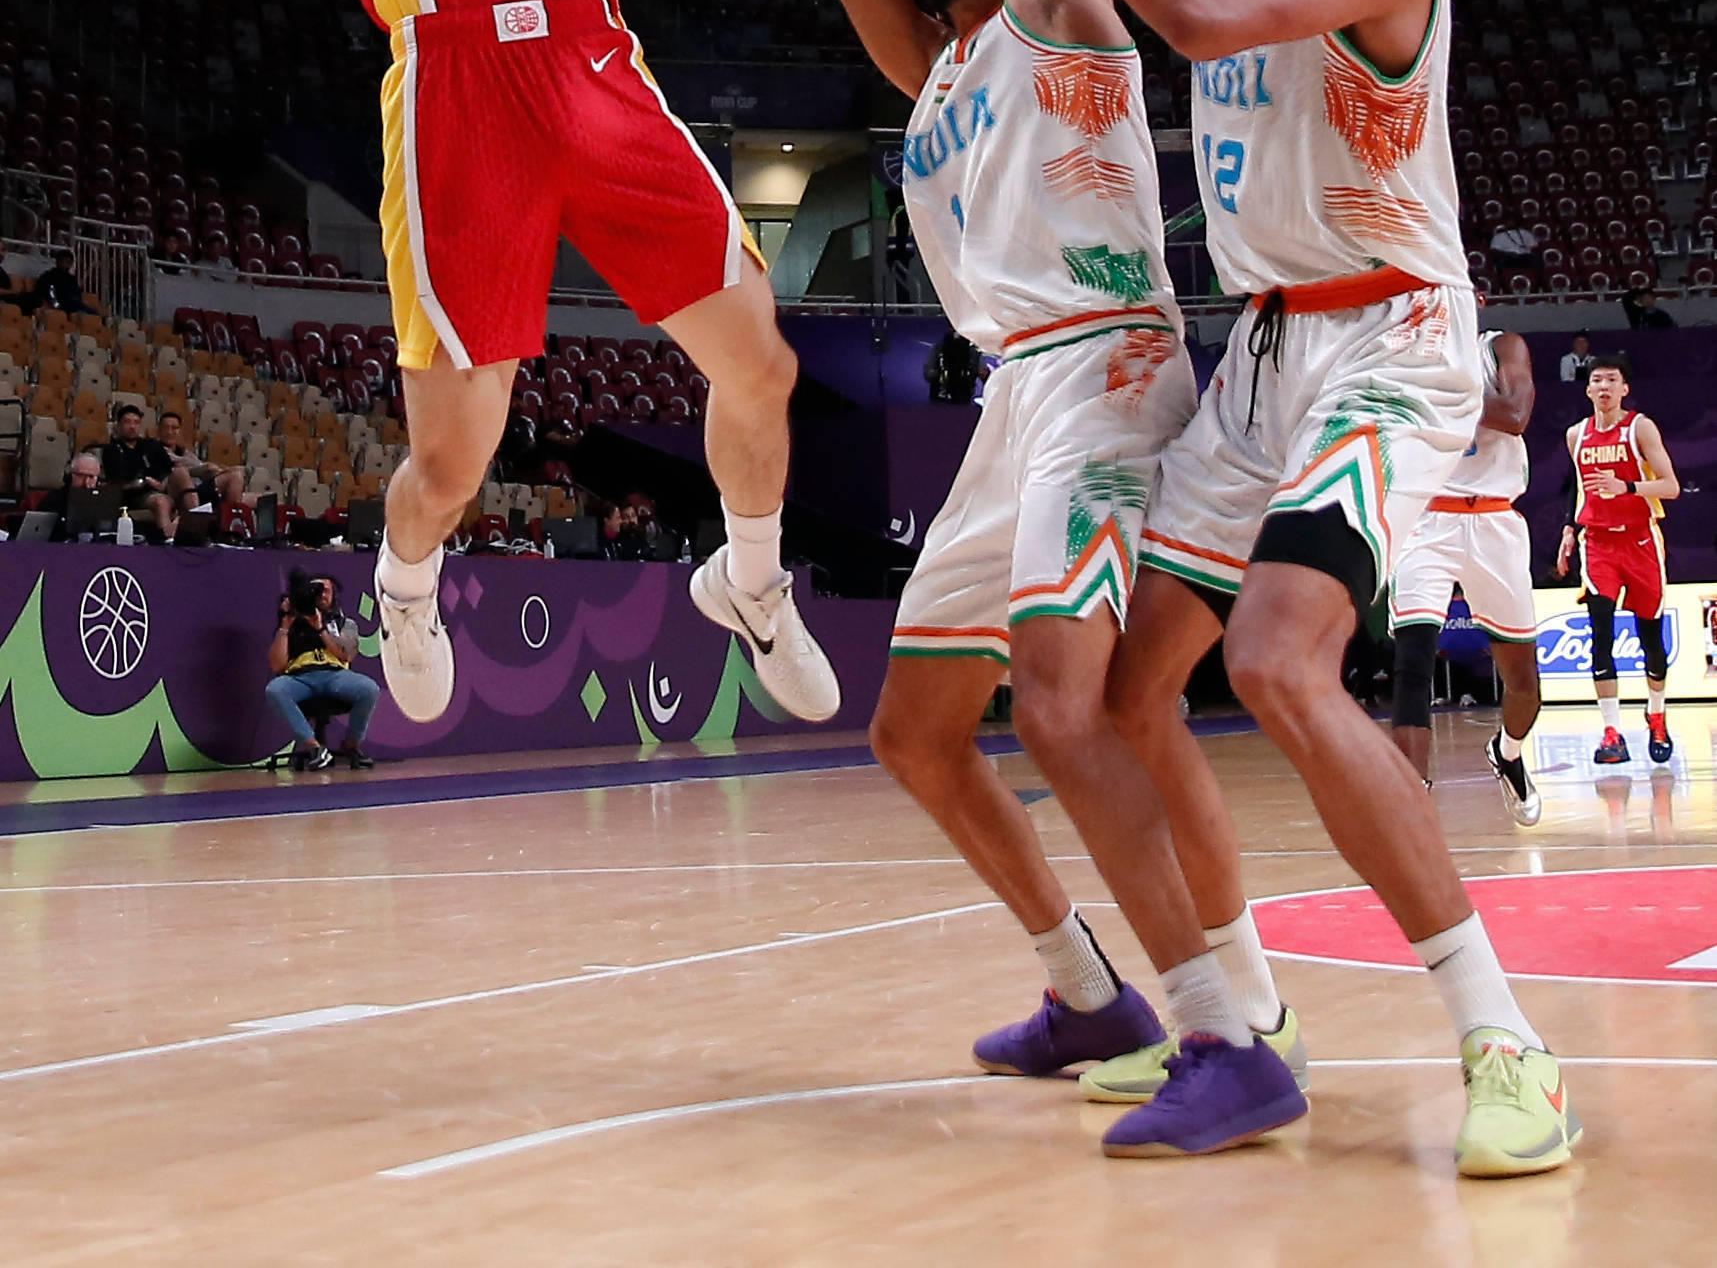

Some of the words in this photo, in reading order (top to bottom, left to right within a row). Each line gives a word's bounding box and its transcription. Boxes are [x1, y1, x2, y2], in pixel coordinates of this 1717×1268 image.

[1193, 55, 1275, 113] NDI
[902, 83, 997, 180] NDIA
[1202, 133, 1246, 214] 12
[1580, 445, 1629, 466] CHINA
[1445, 616, 1474, 630] olte
